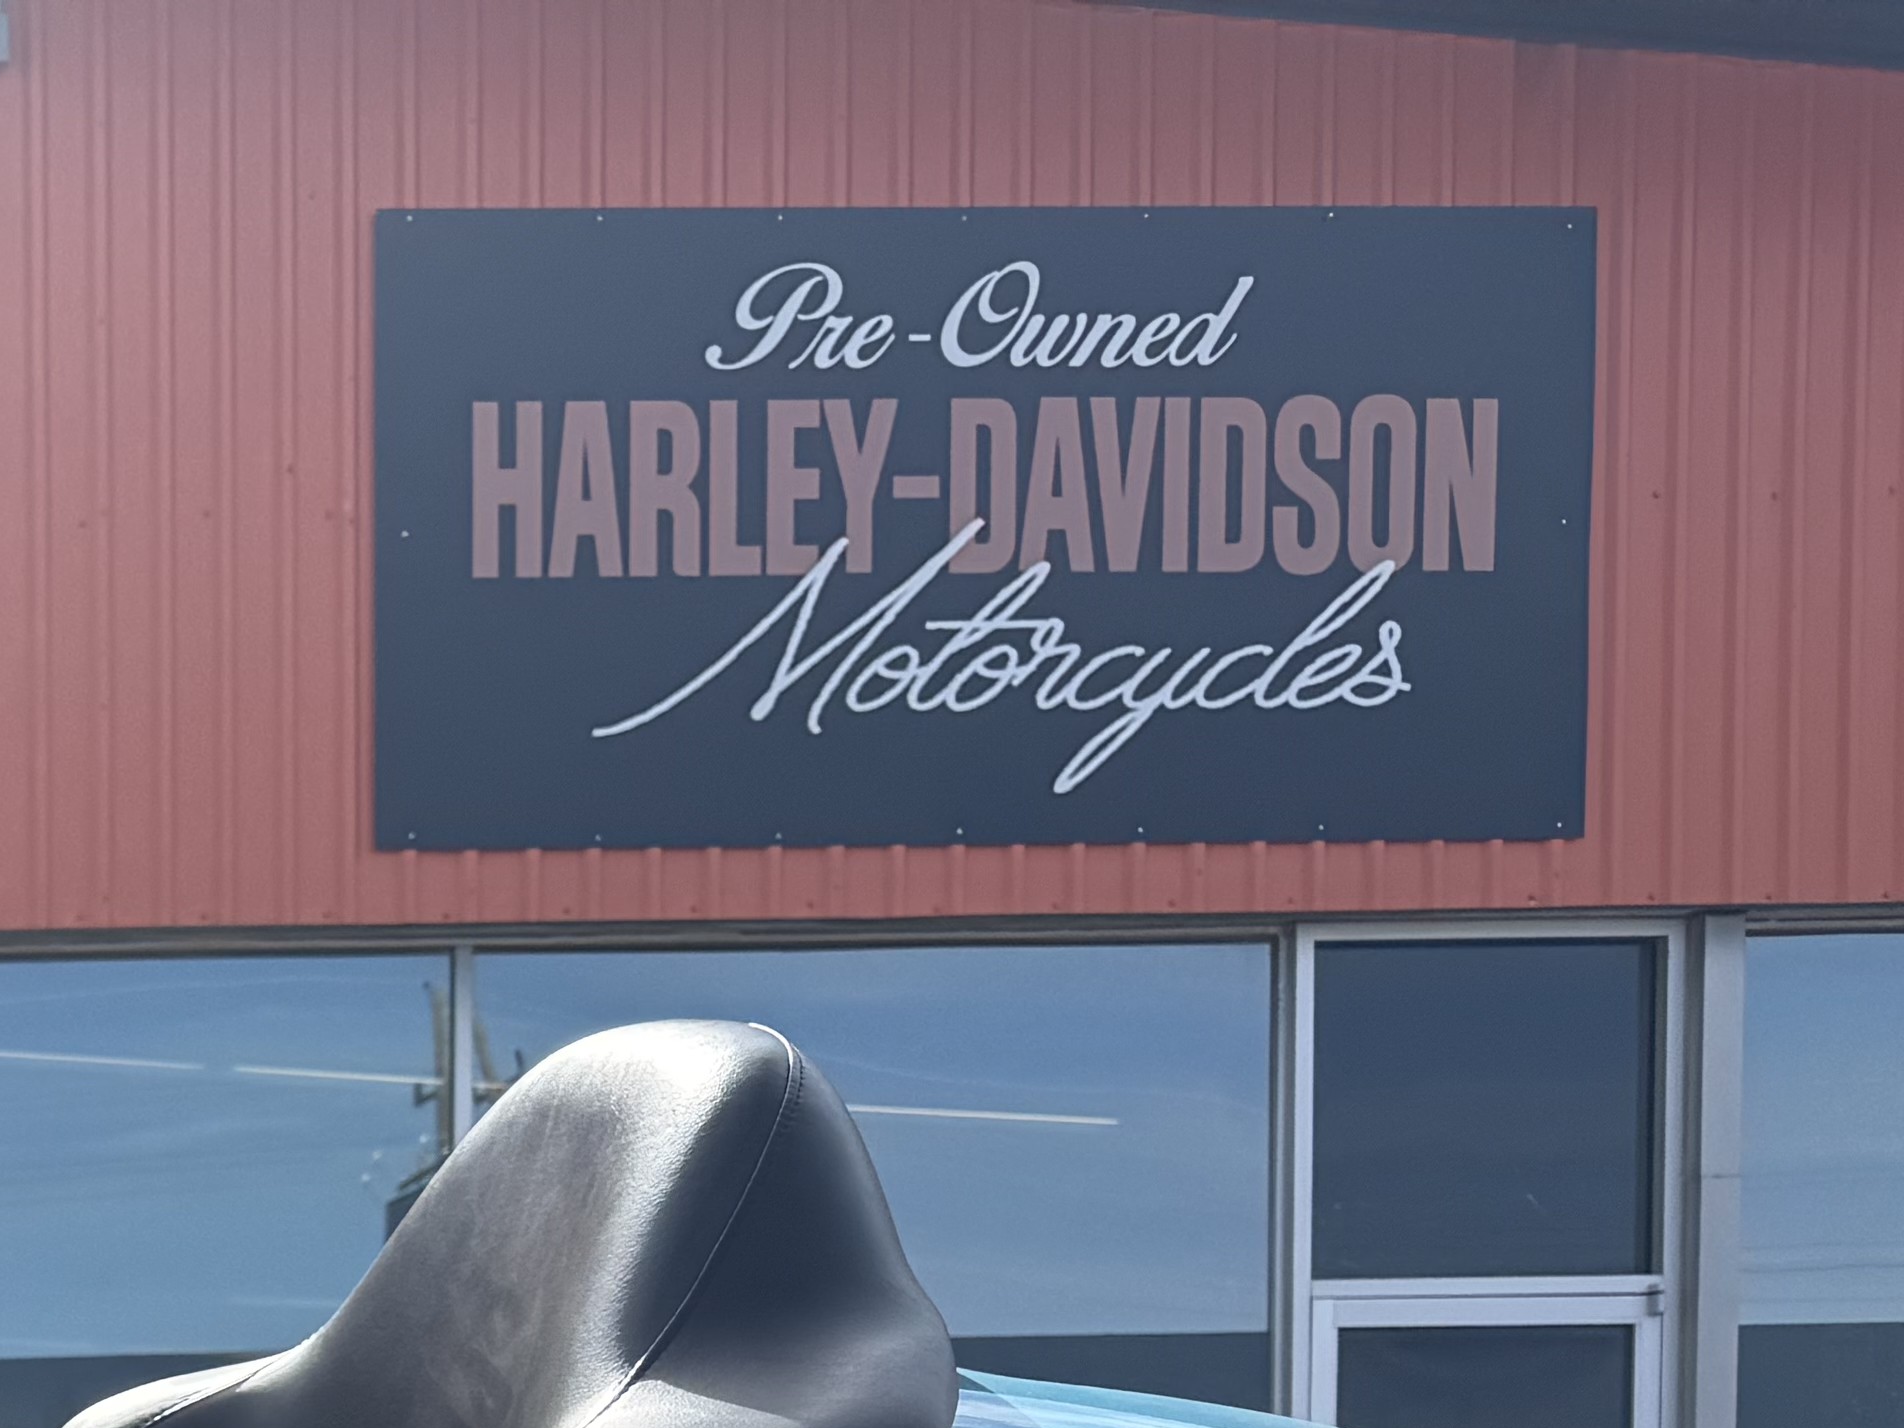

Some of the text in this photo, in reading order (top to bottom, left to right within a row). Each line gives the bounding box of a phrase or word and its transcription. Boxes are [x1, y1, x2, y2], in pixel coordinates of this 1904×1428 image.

[705, 260, 1255, 371] Pre-Owned
[471, 396, 1499, 578] HARLEY-DAVIDSON
[593, 519, 1412, 794] Motorcycles
